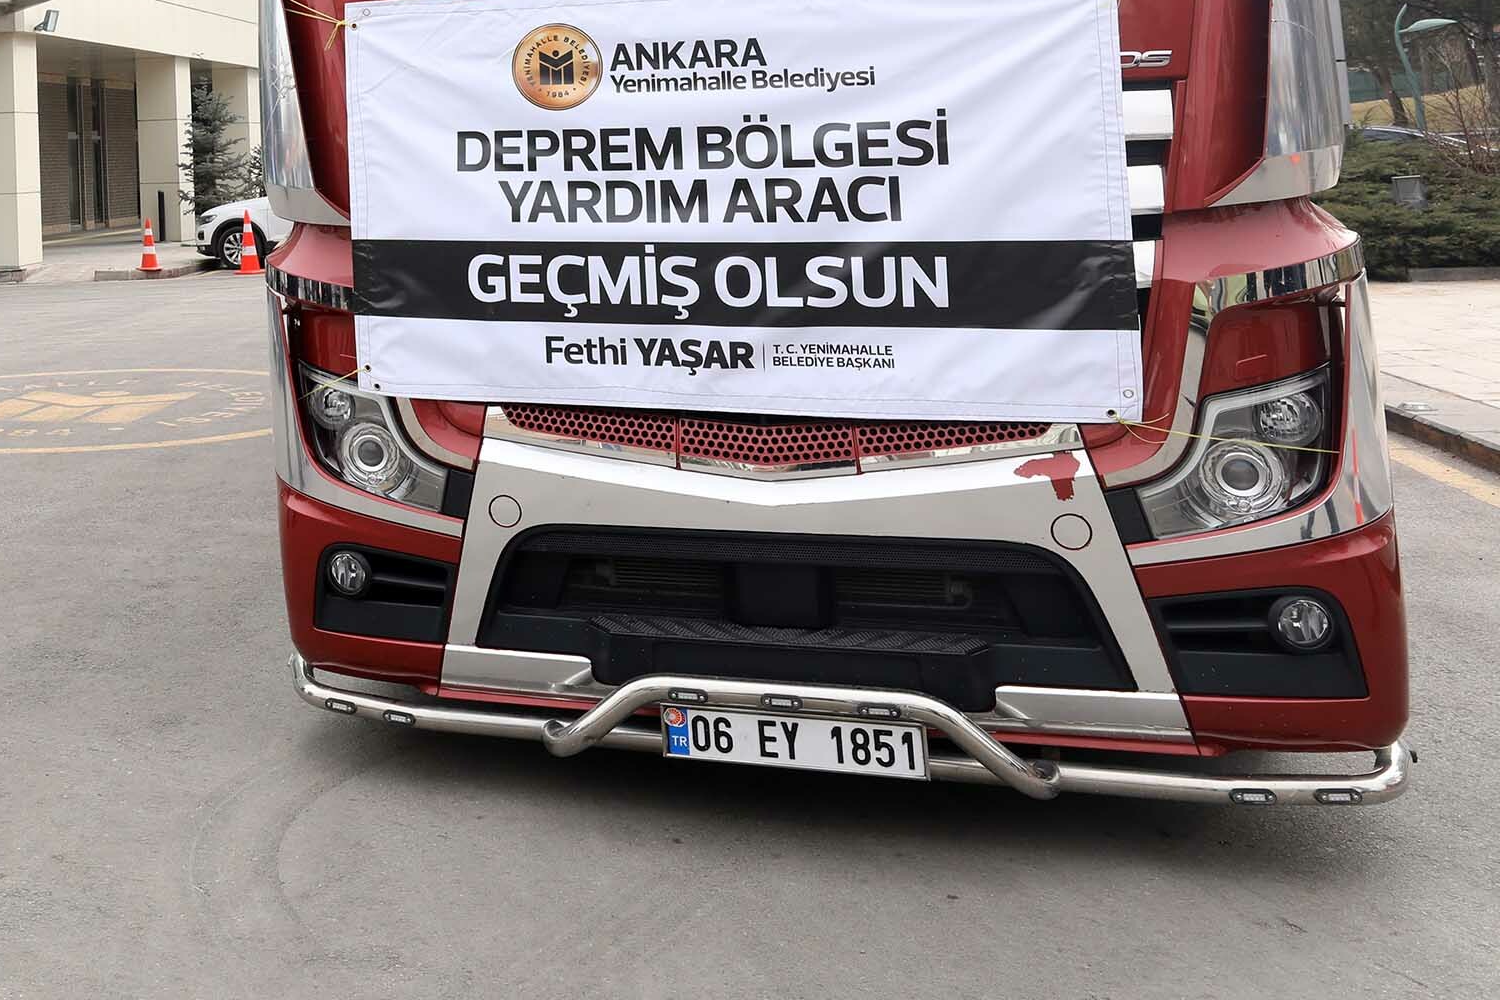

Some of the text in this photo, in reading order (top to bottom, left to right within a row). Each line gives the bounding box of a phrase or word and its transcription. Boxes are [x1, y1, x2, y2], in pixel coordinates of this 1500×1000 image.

[610, 38, 767, 71] ANKARA
[610, 66, 876, 93] Yenimahalle Belediyesi
[457, 108, 949, 172] DEPREM BÖLGESİ
[499, 175, 902, 223] YARDIM ARACI
[468, 244, 949, 319] GEÇMİŞ OLSUN
[545, 336, 755, 376] Fethi YAŞAR
[773, 354, 895, 371] BELEDİYE BAŞKANI
[799, 341, 893, 356] YENİMAHALLE
[672, 715, 916, 770] TR 06 EY 1851
